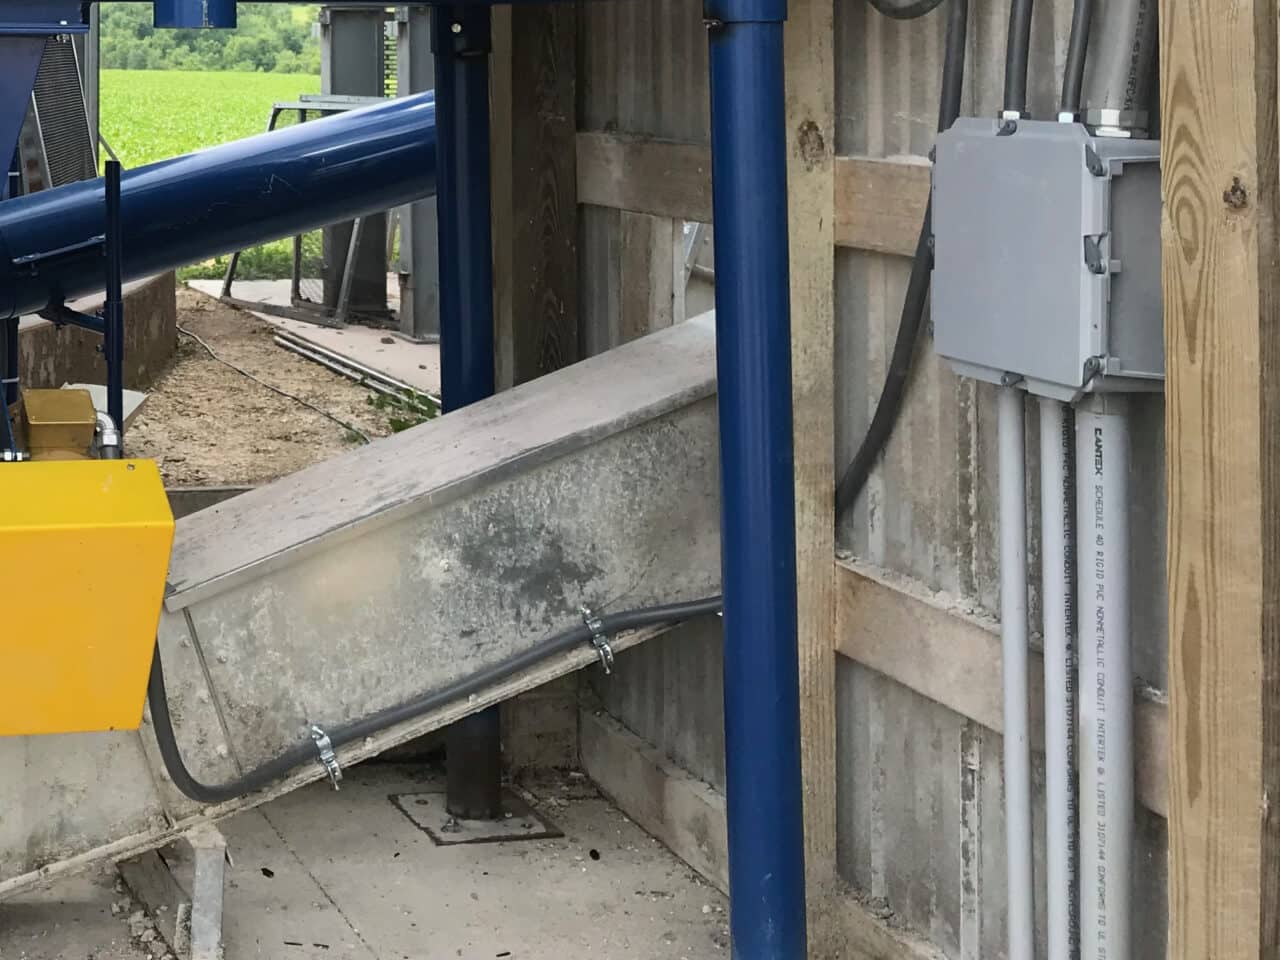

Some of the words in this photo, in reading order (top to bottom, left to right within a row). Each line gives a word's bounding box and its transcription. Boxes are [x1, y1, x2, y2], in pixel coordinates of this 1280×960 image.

[1094, 427, 1103, 476] CANTEX
[1095, 484, 1105, 529] SCHEDULE
[1095, 534, 1105, 546] 40
[1096, 550, 1105, 579] RIGID
[1096, 583, 1105, 601] PVC
[1096, 606, 1105, 669] NONMETALLIC
[1096, 672, 1106, 713] CONDUIT
[1097, 718, 1106, 763] INTERTEK
[1097, 782, 1106, 817] LISTED
